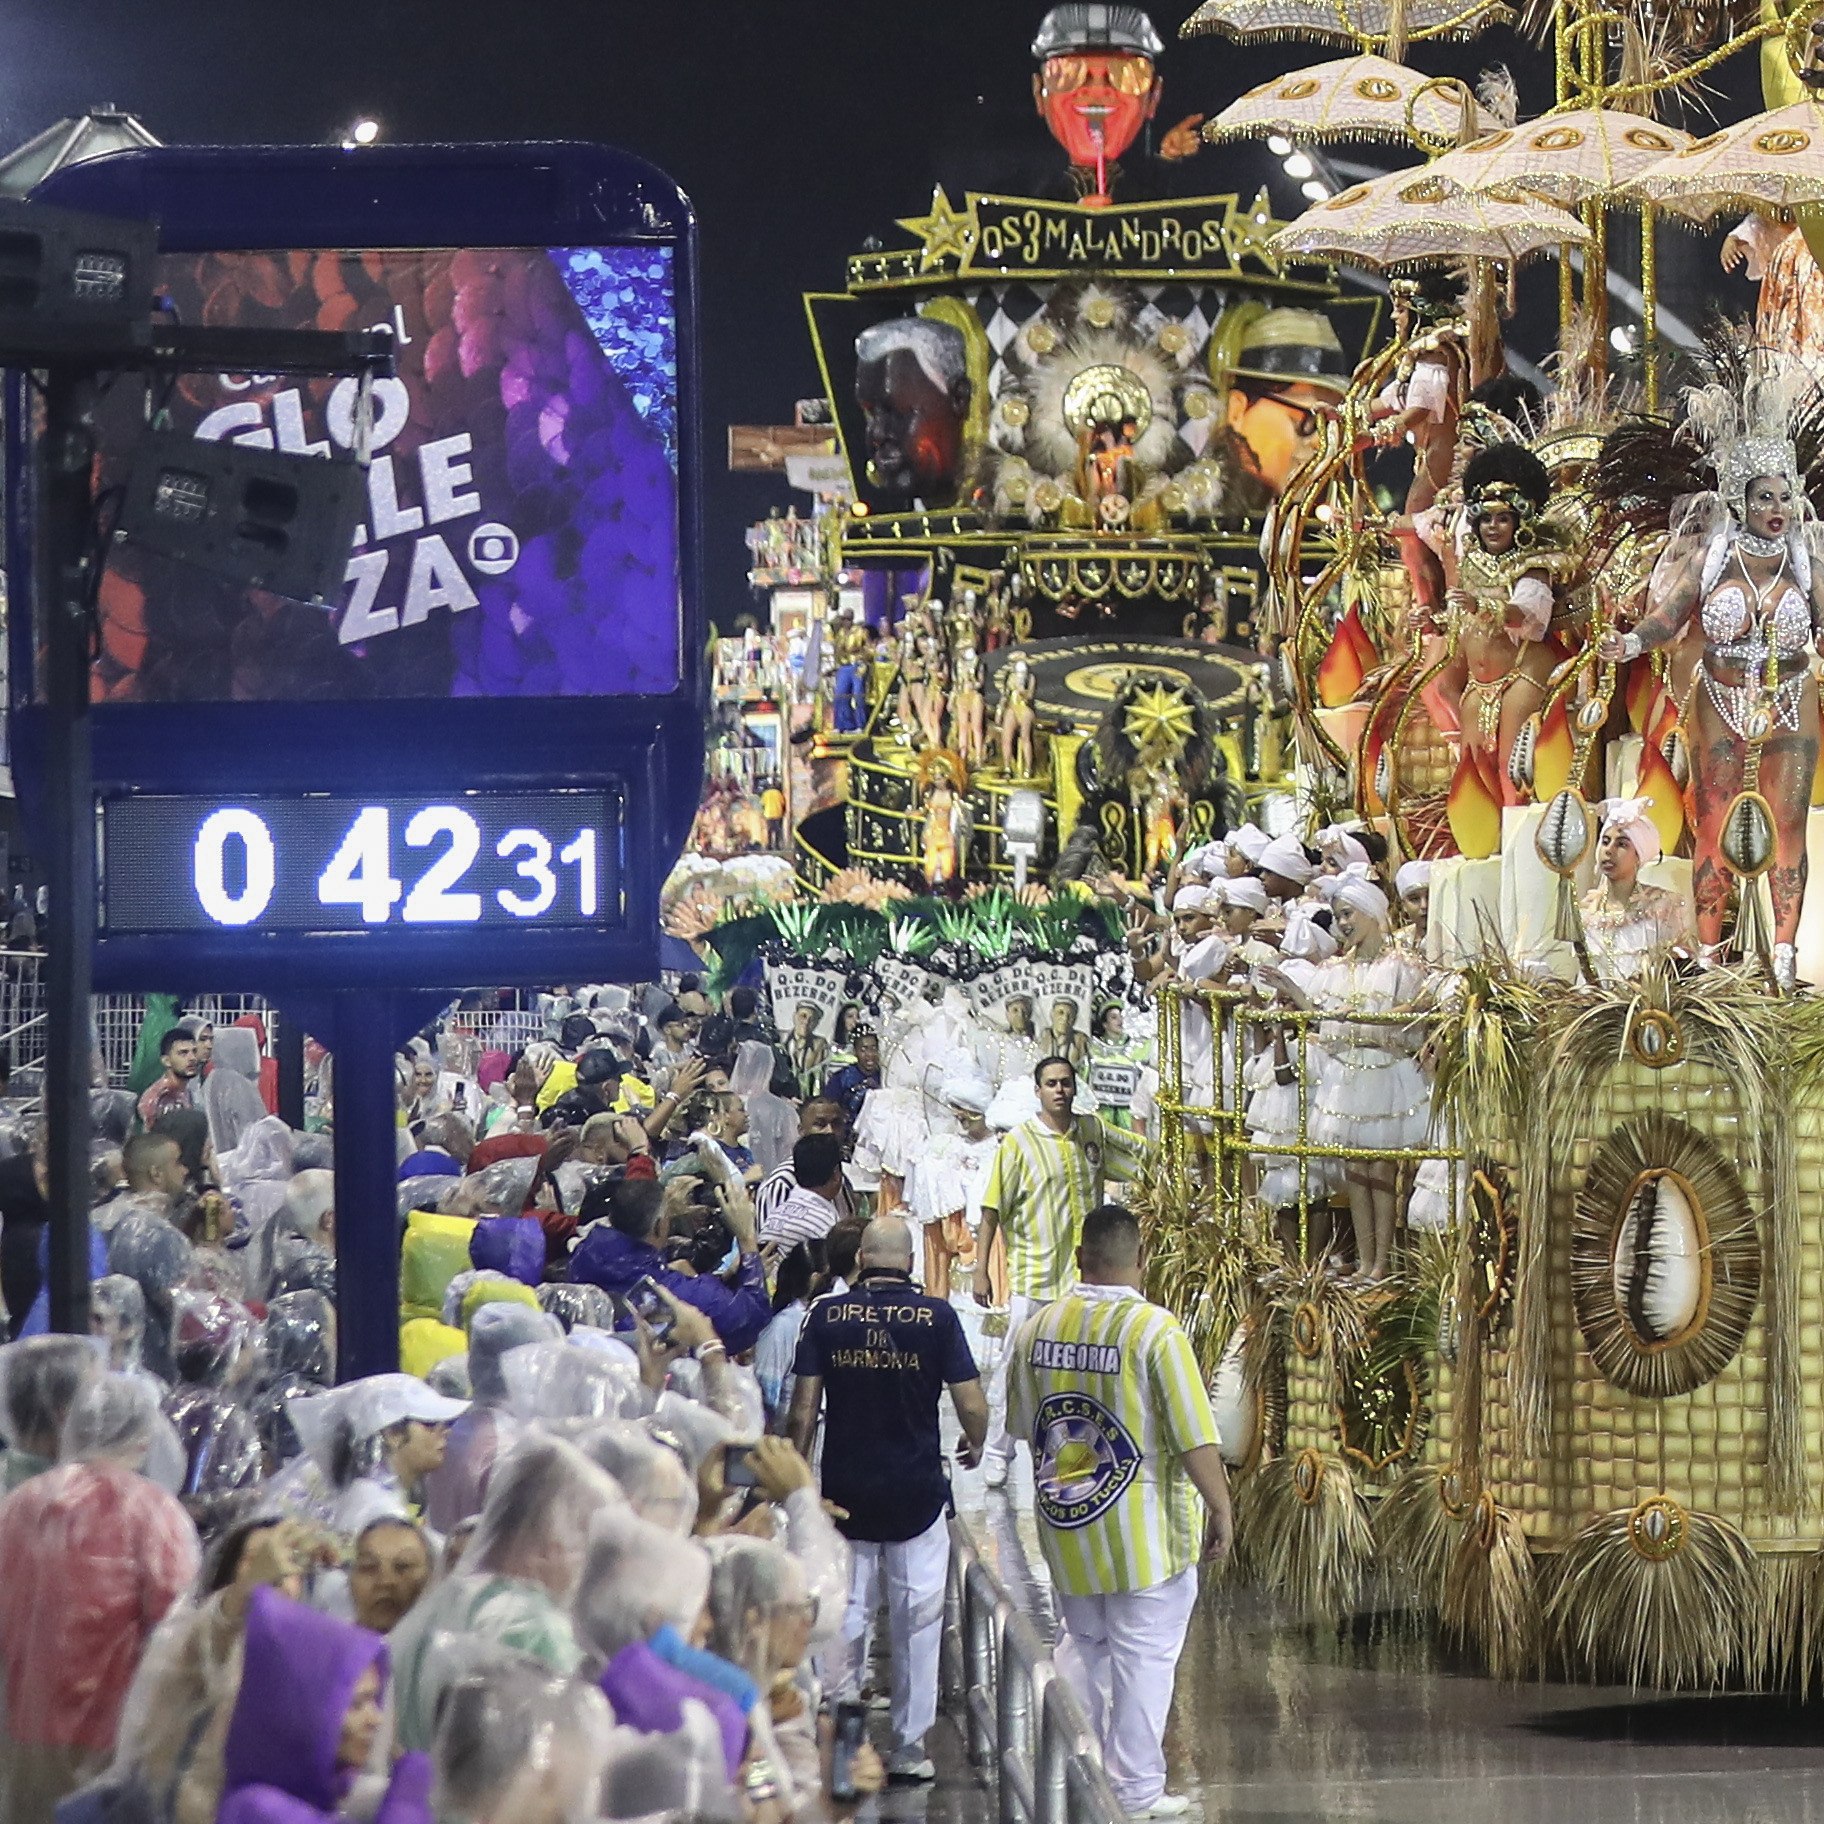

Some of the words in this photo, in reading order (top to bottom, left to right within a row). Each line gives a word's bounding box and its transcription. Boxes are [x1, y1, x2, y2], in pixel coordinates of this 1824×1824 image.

[194, 808, 276, 925] 0
[318, 807, 482, 923] 42
[496, 828, 598, 916] 31
[815, 974, 837, 991] DO
[773, 984, 837, 1009] BEZERRA
[826, 1304, 935, 1327] DIRETOR
[1031, 1339, 1121, 1374] ALEGORIA
